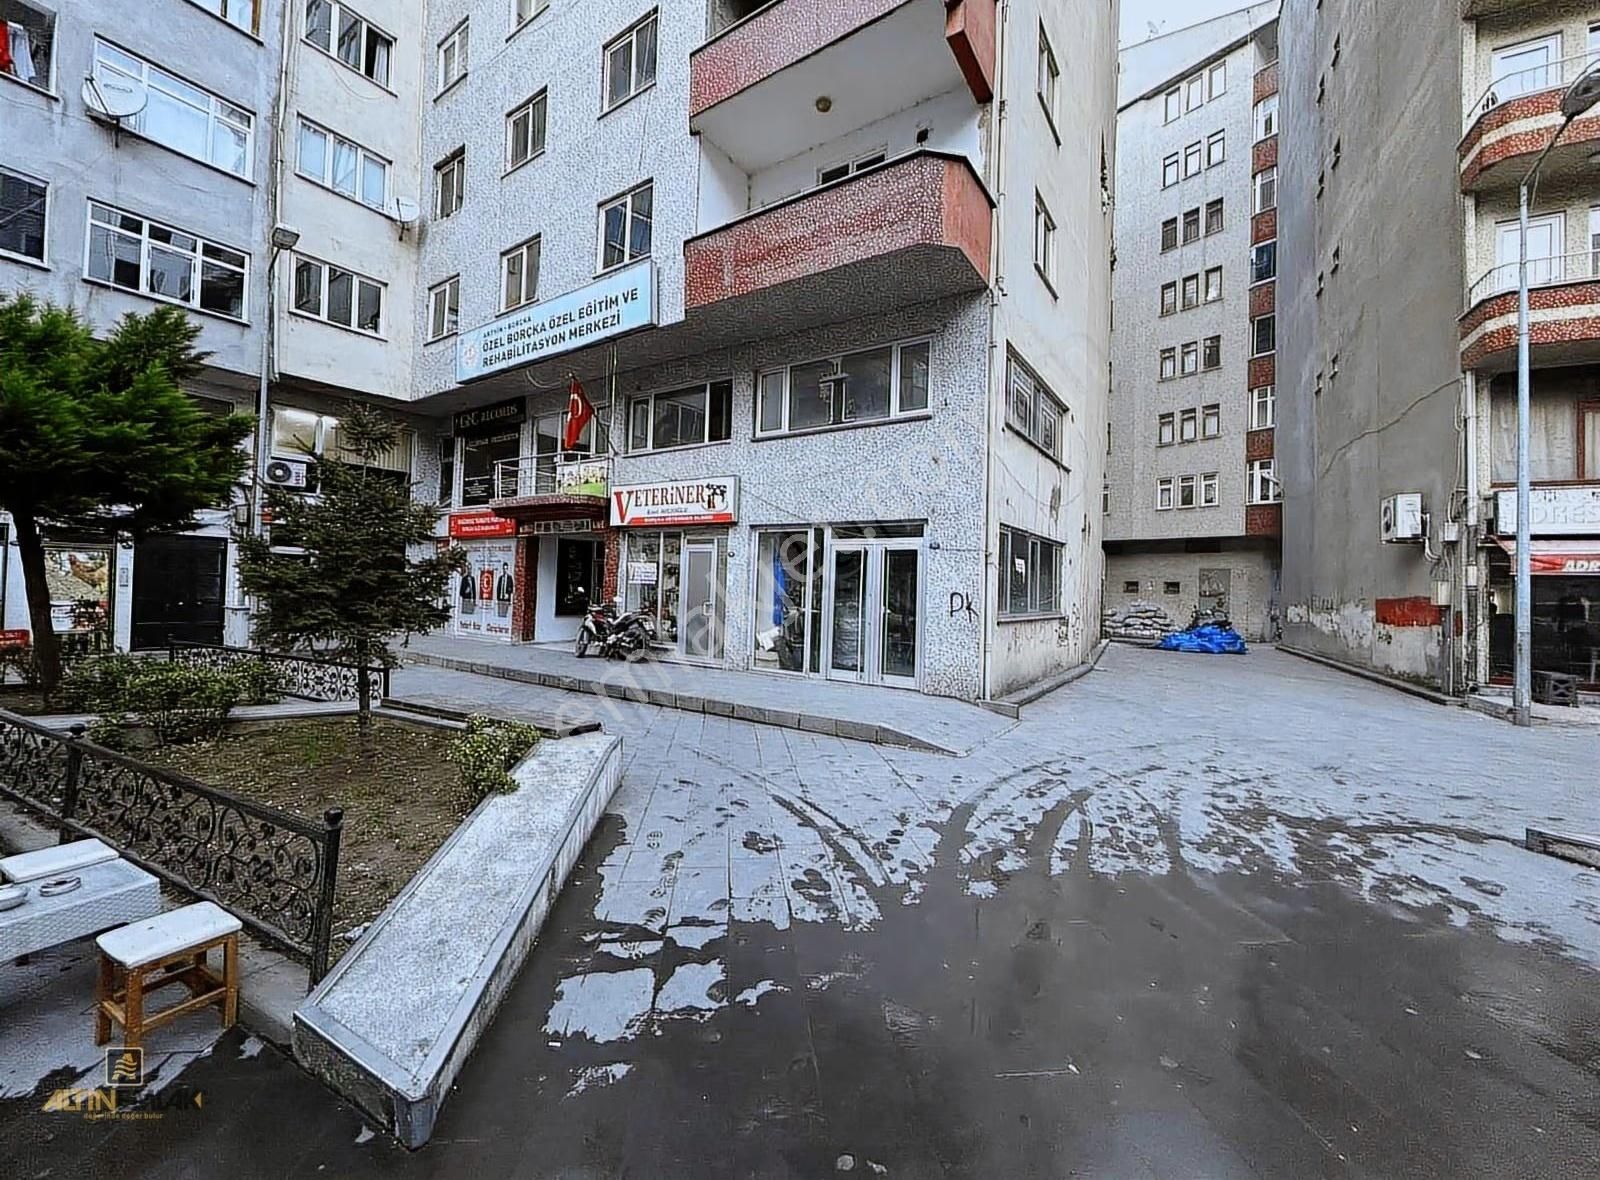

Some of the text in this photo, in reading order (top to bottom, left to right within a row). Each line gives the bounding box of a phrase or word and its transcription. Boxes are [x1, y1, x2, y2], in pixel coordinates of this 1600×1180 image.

[482, 287, 639, 352] ÖZEL BORÇKA ÖZEL EĞİTİM VE
[482, 309, 621, 367] REHABİLİTASYON MERKEZİ
